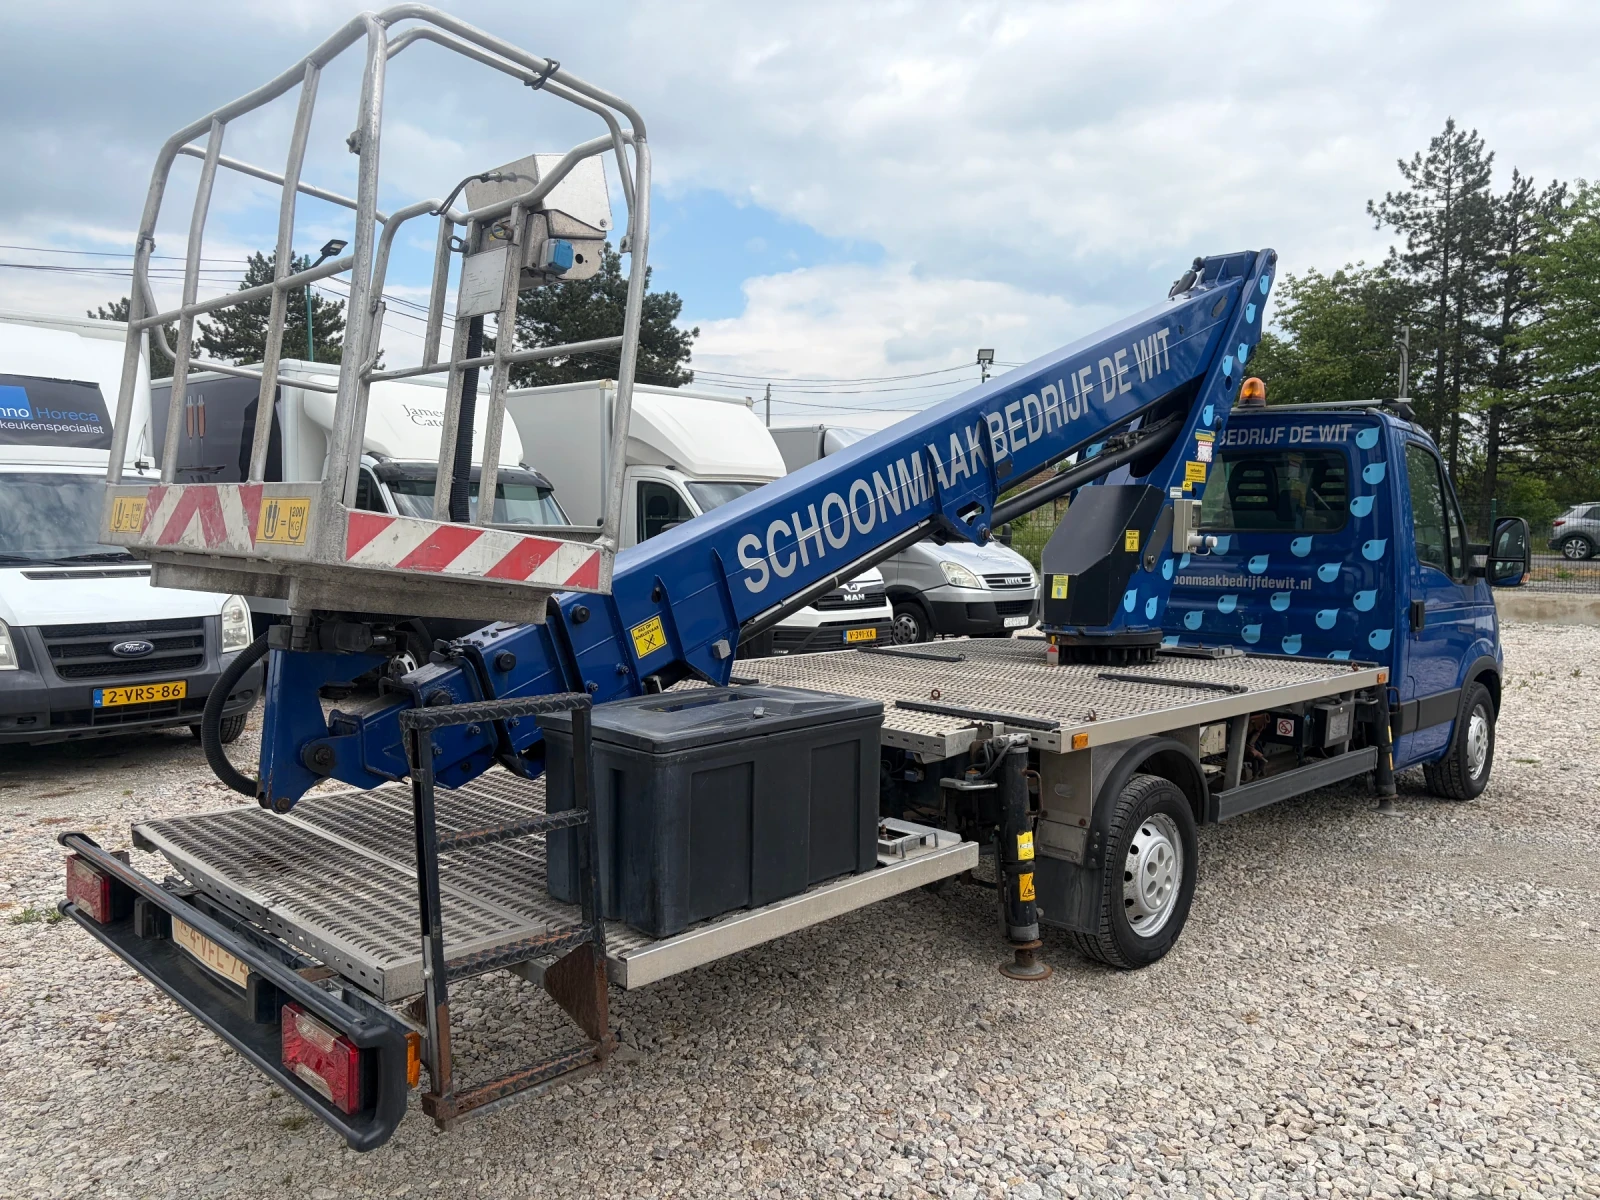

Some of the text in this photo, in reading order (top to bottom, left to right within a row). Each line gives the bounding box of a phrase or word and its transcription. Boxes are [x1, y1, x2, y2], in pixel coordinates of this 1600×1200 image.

[36, 406, 99, 422] Horeca
[0, 420, 105, 434] keukenspecialist
[1289, 425, 1314, 443] DE
[1319, 423, 1353, 442] WIT
[737, 327, 1171, 593] SCHOONMAAKBEDRIJF DE WIT
[292, 506, 303, 517] 200
[290, 520, 300, 531] KG
[843, 593, 865, 601] MAN
[123, 643, 146, 652] Ford
[108, 684, 181, 703] 2-VRS-86
